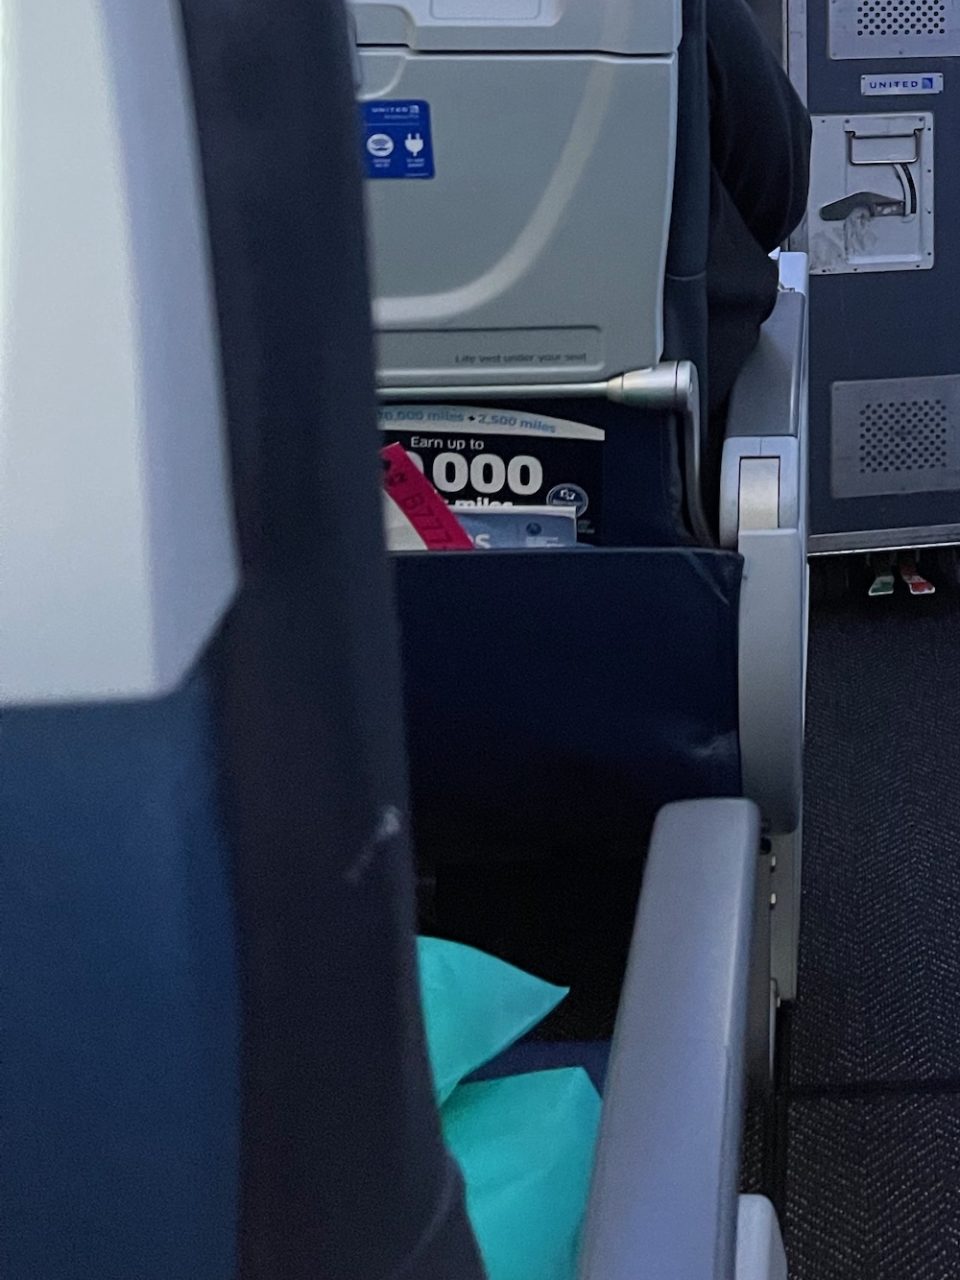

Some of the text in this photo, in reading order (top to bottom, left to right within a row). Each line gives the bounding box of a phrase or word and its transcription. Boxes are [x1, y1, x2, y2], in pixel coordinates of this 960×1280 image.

[503, 354, 534, 362] under
[538, 354, 561, 362] your
[428, 410, 464, 422] miles
[478, 414, 516, 426] 2,500
[520, 419, 556, 433] miles
[410, 436, 484, 450] Earn up to
[406, 451, 543, 495] 000
